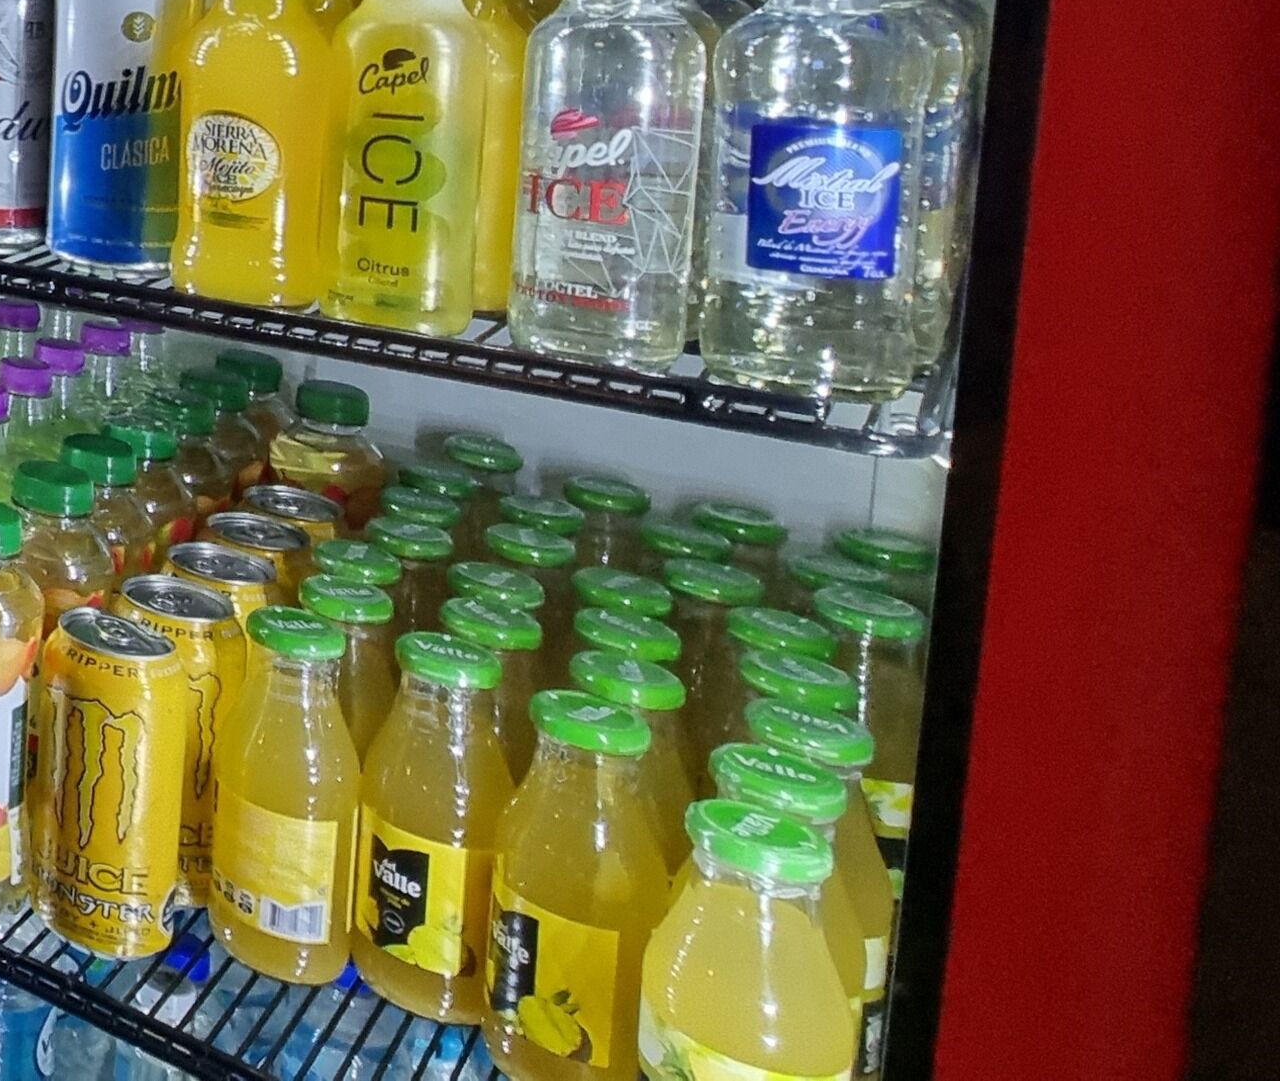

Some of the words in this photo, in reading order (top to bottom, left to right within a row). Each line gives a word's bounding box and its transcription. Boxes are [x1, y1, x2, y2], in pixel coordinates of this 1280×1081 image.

[358, 56, 430, 95] Capel
[204, 119, 257, 143] SIERRA
[358, 112, 425, 232] ICE
[798, 188, 855, 210] ICE
[357, 257, 410, 277] Citrus
[65, 647, 140, 679] RIPPER
[42, 867, 155, 924] ONSTER
[372, 858, 422, 899] Valle
